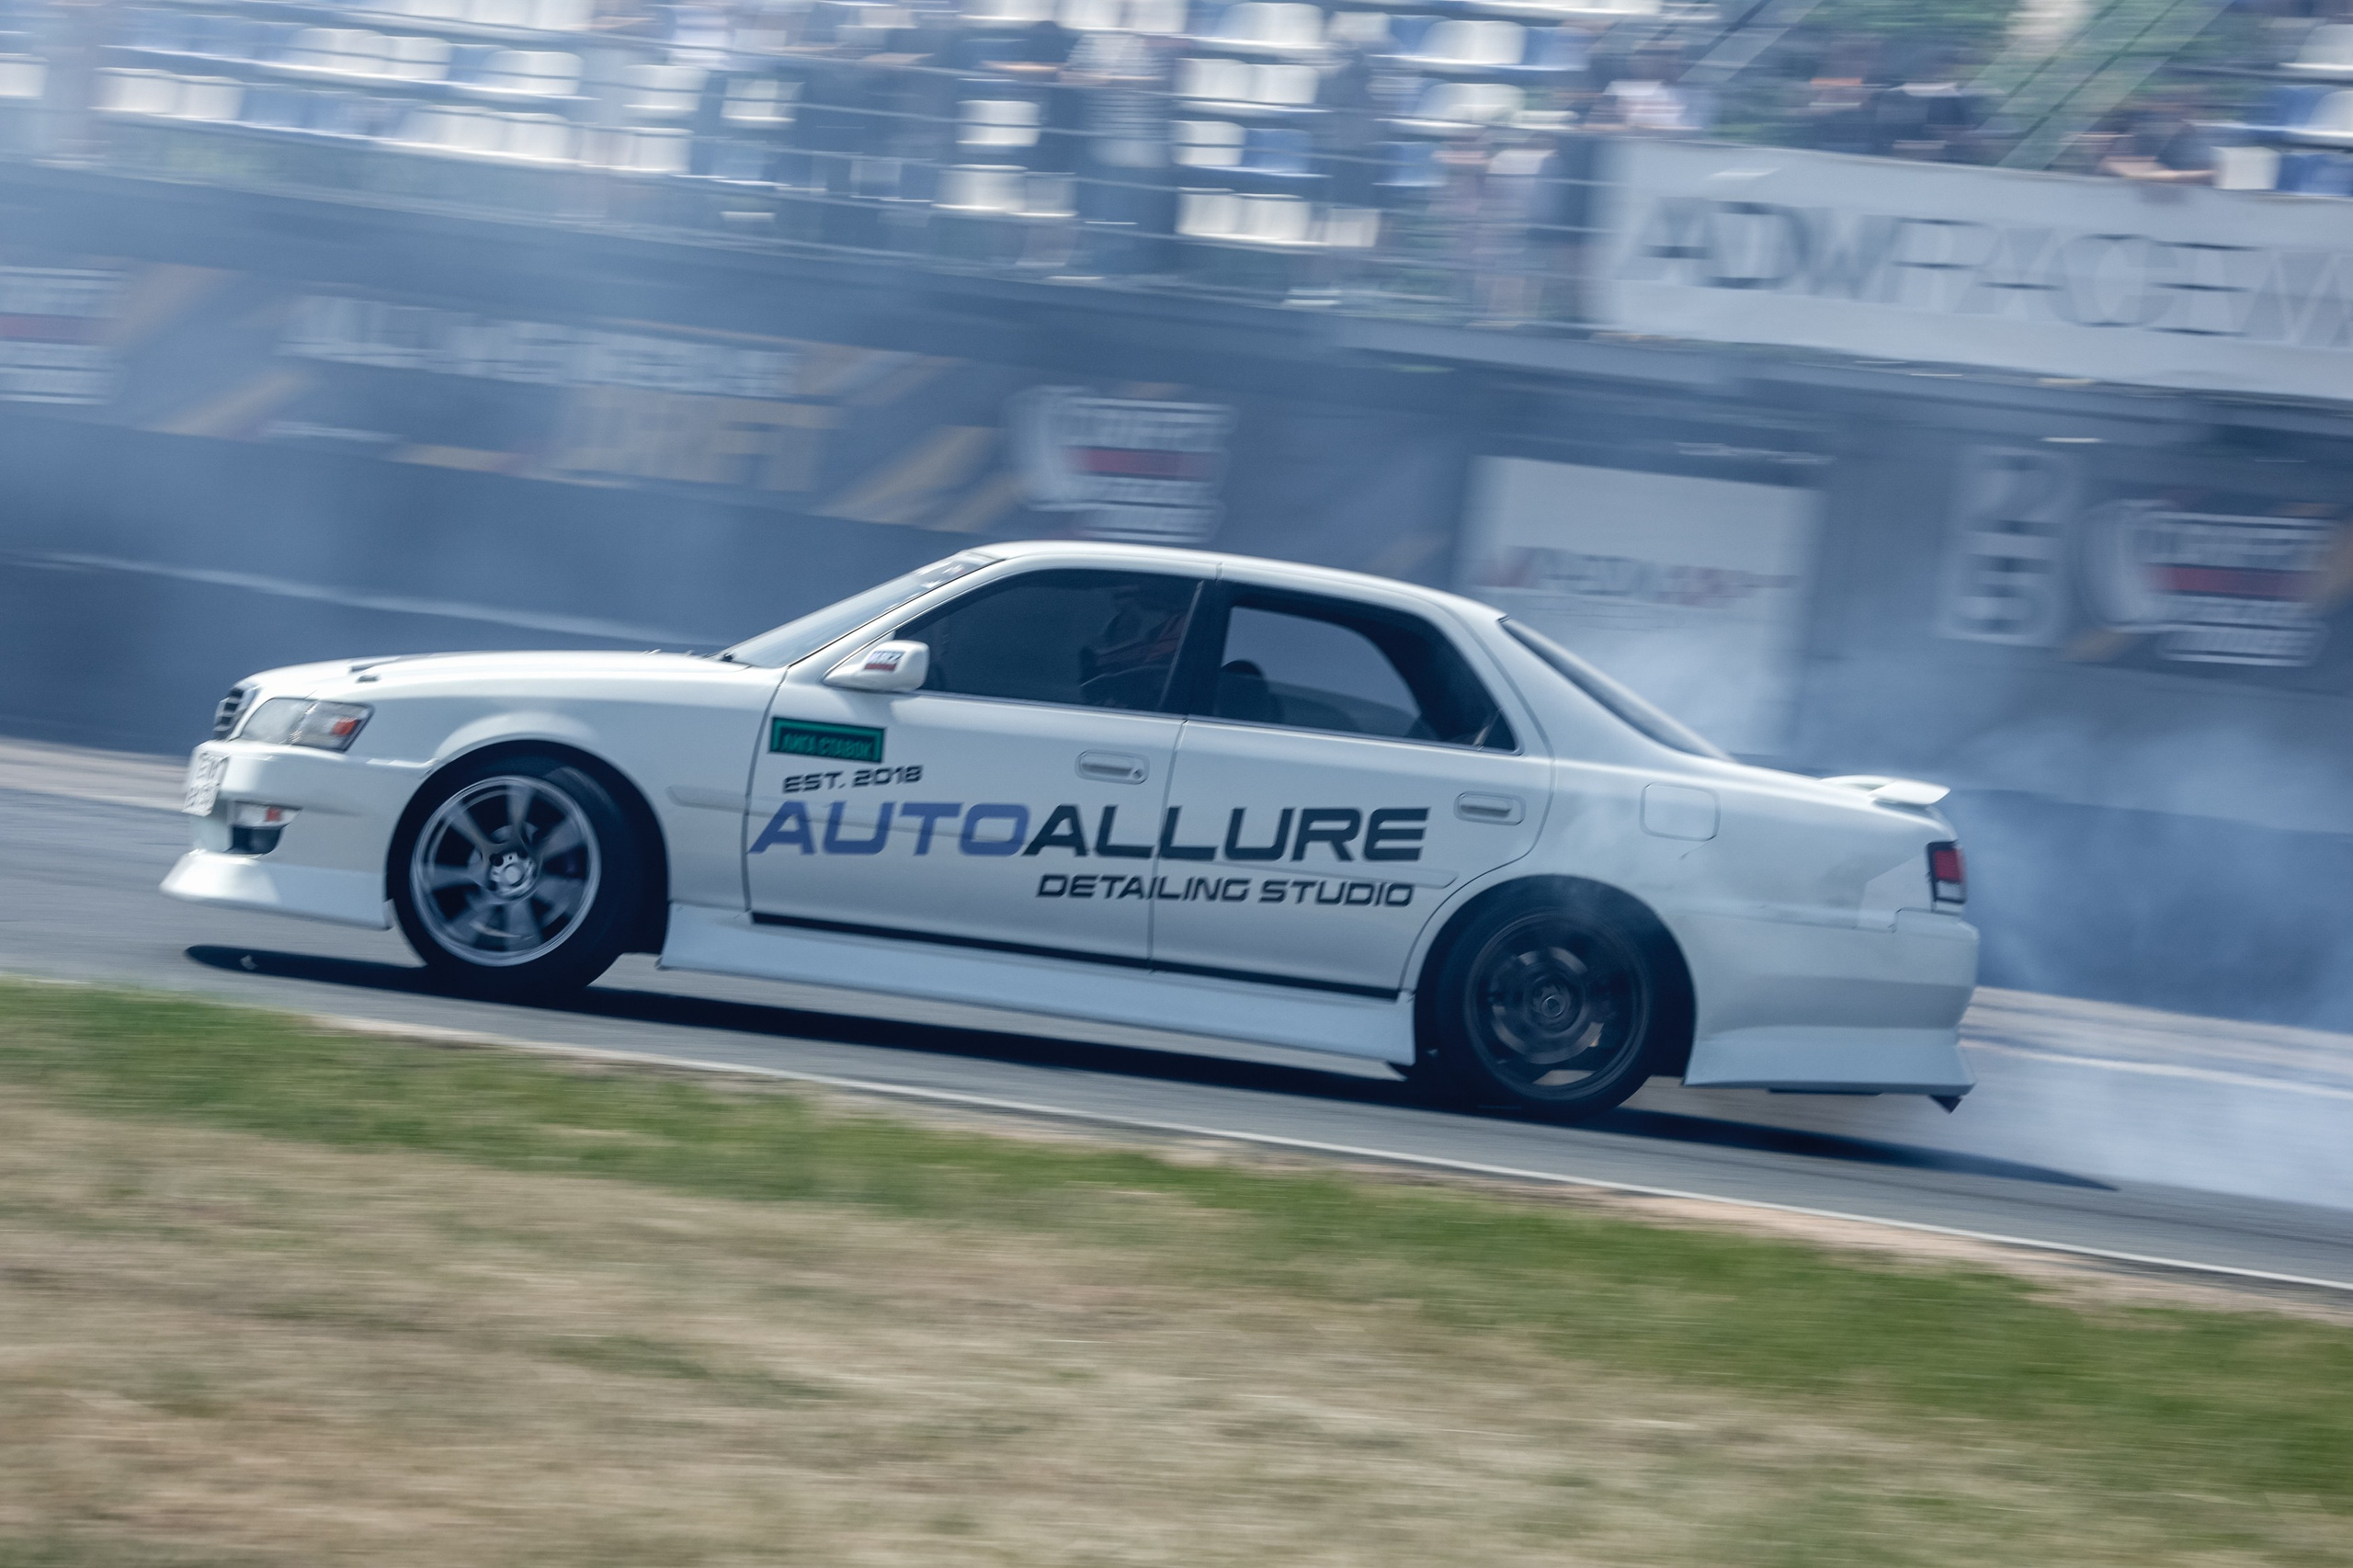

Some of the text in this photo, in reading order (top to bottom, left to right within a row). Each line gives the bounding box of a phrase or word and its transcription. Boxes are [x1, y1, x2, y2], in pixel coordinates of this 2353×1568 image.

[783, 765, 924, 793] EST. 2018
[1036, 873, 1415, 908] DETAILING STUDIO
